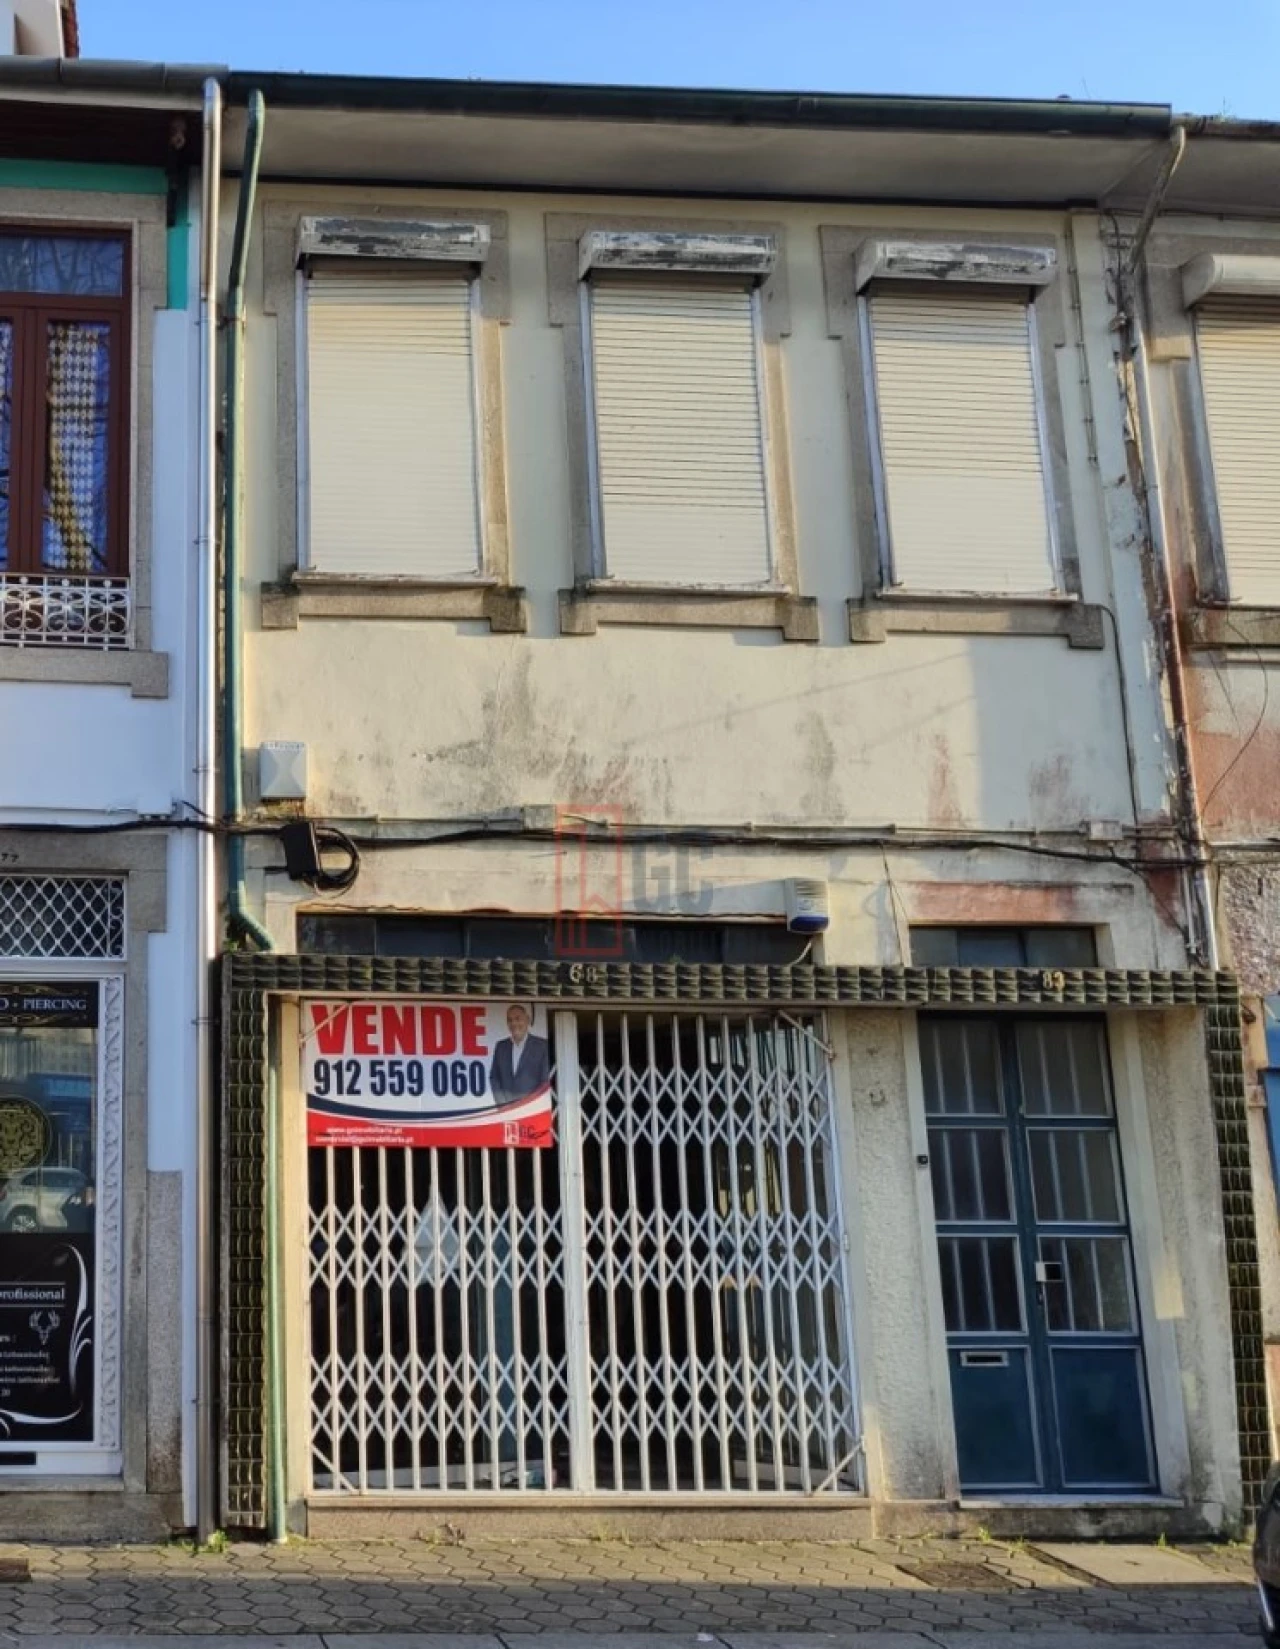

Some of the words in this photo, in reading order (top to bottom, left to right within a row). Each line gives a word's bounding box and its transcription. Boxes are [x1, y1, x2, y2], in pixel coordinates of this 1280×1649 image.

[24, 997, 87, 1011] PIERCING
[311, 1004, 489, 1056] VENDE
[314, 1059, 362, 1096] 912
[370, 1060, 424, 1097] 559
[432, 1060, 486, 1097] 060
